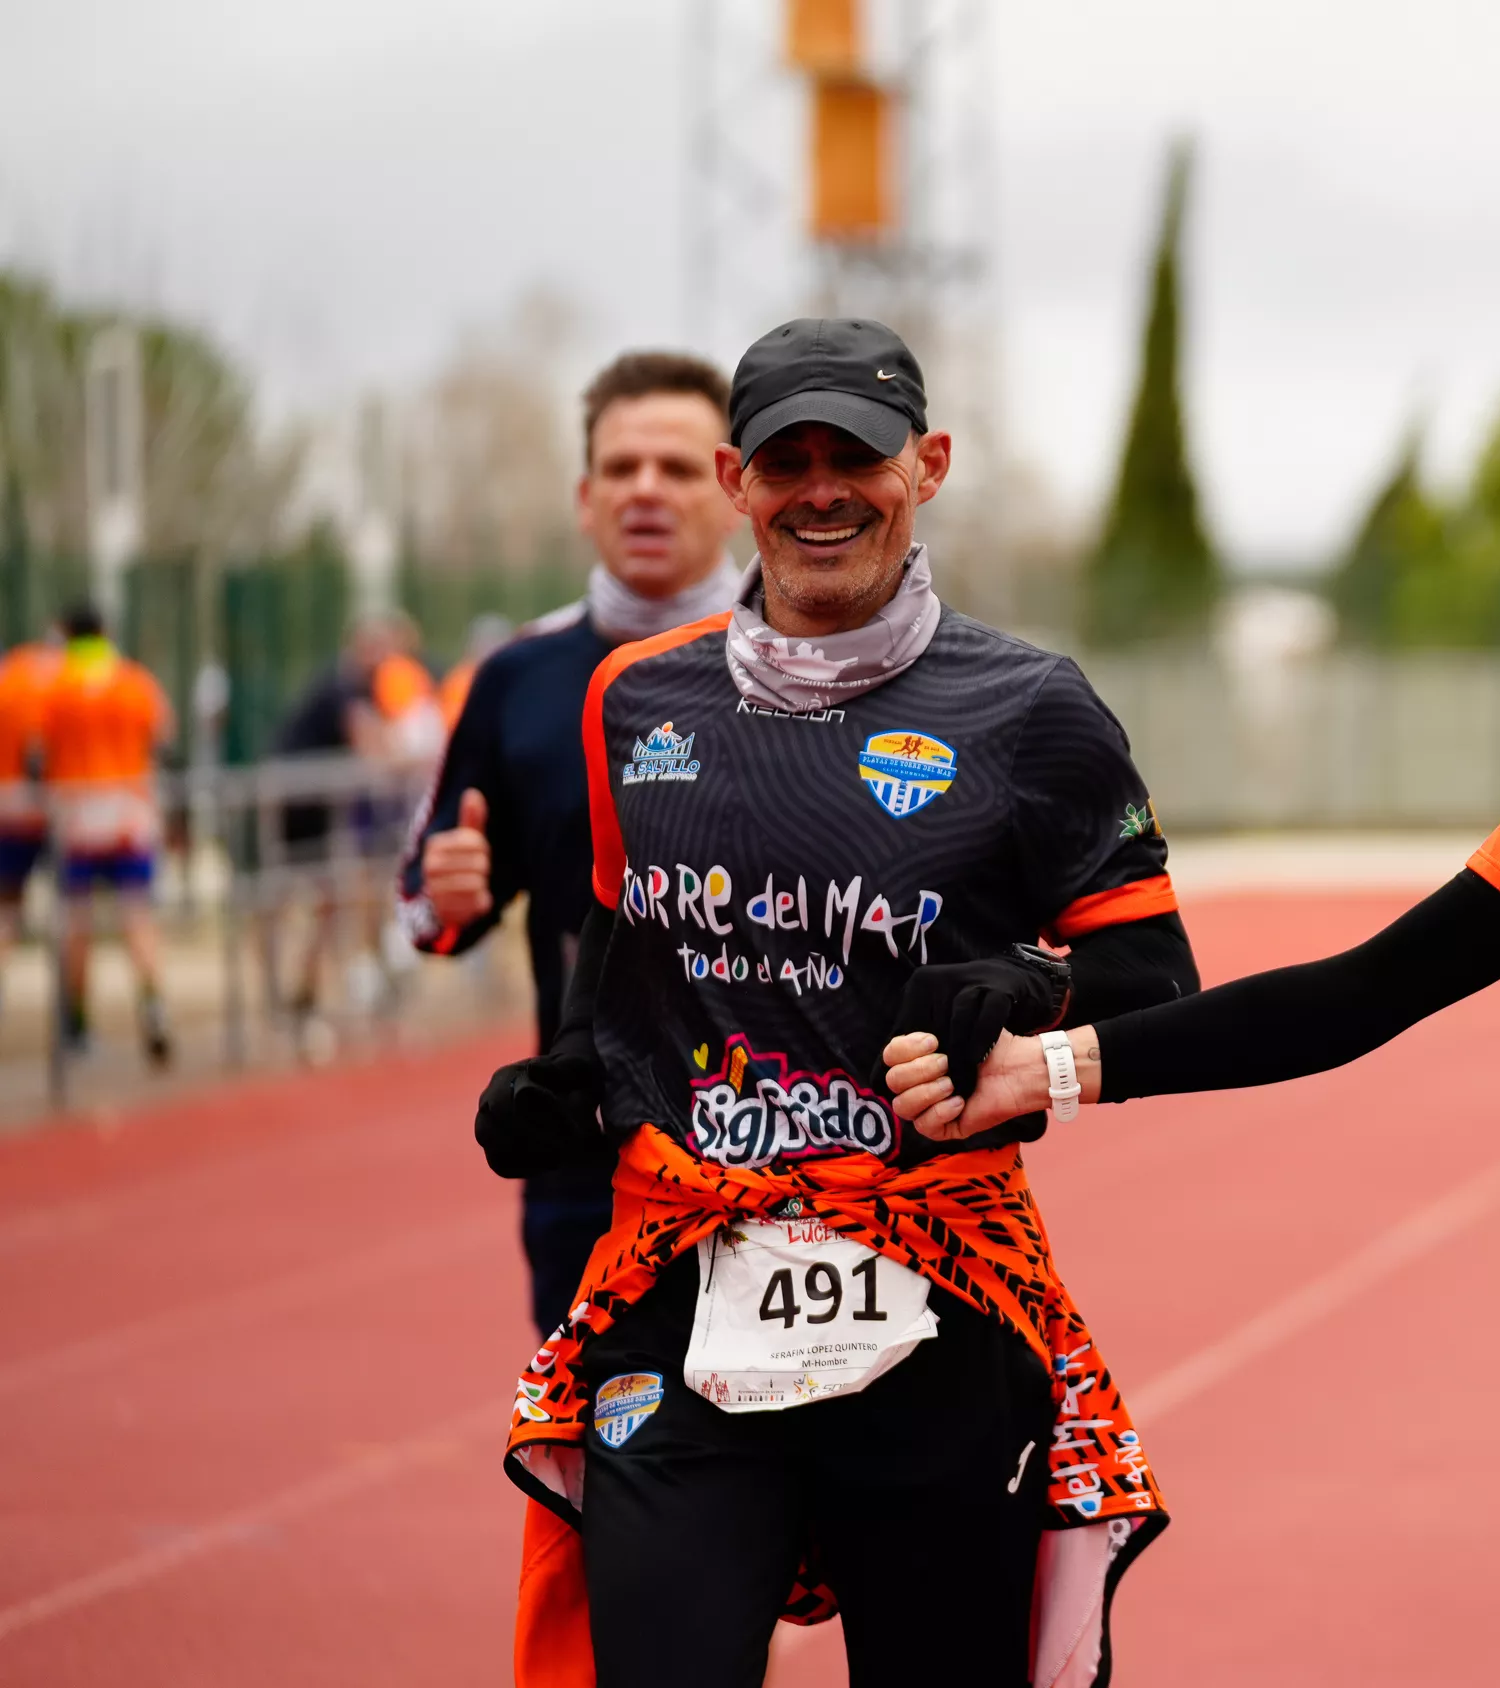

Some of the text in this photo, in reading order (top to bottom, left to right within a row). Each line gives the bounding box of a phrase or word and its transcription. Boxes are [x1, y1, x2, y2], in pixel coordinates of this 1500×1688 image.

[622, 759, 701, 777] EL SALTILLO
[862, 755, 888, 765] PLAYAS
[899, 760, 920, 769] TORRE
[922, 764, 935, 773] DEL
[936, 767, 952, 777] MAR
[746, 872, 808, 932] del
[823, 875, 943, 965] MAR
[756, 953, 773, 984] el
[694, 1082, 890, 1168] Sigfrido
[787, 1221, 847, 1245] LUCEN
[759, 1258, 888, 1330] 491
[769, 1342, 878, 1361] SERAFIN LOPEZ QUINTERO
[801, 1357, 848, 1369] M-Hombre
[1051, 1462, 1104, 1519] del
